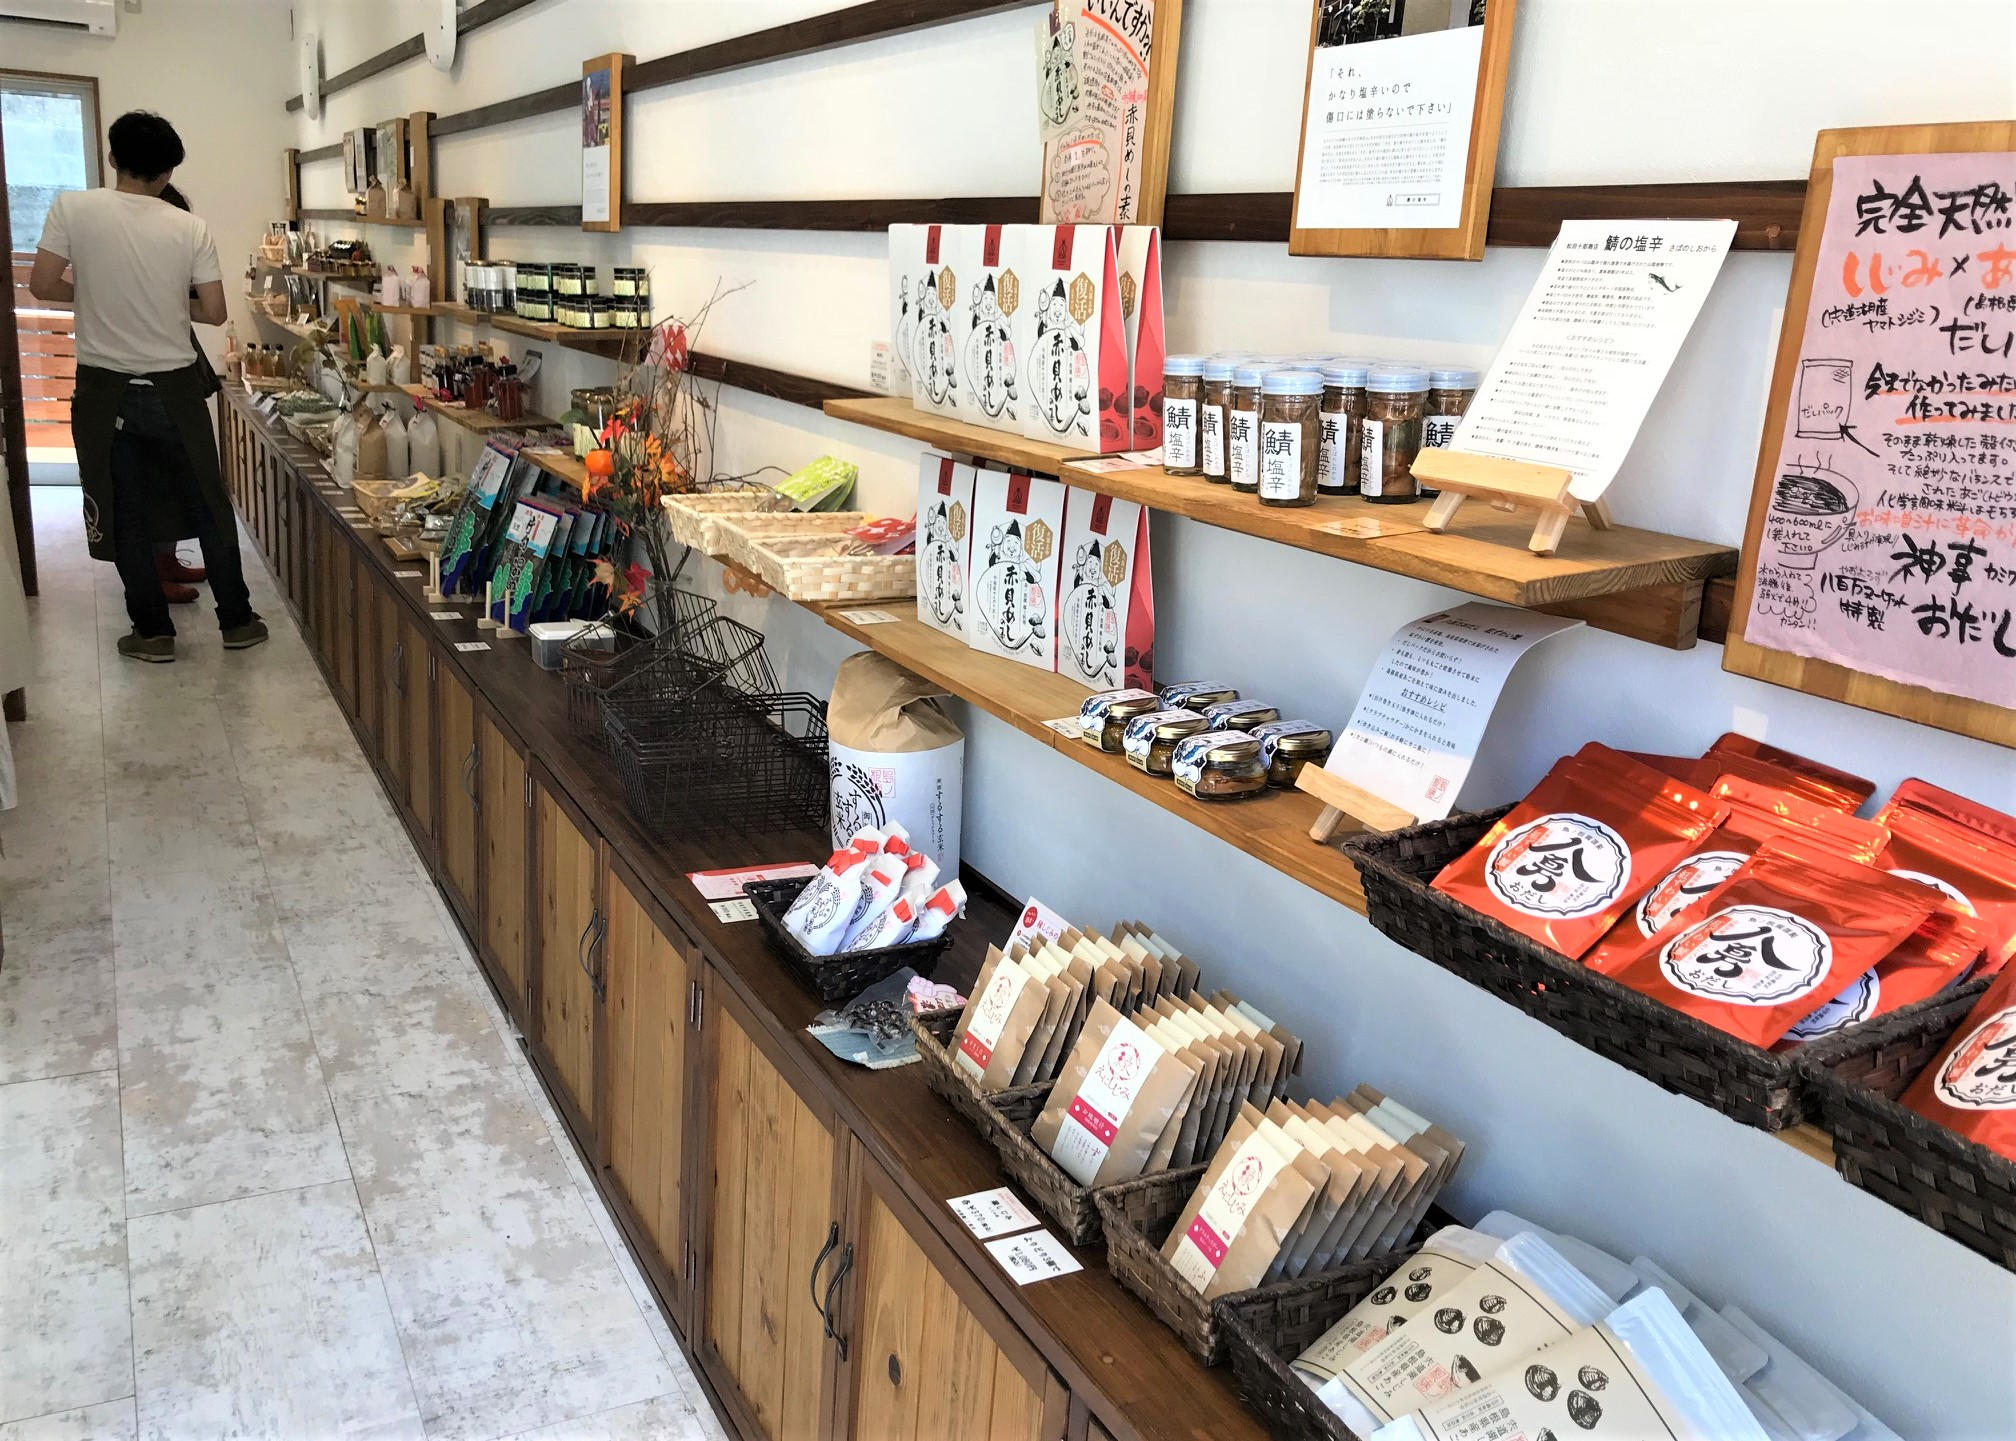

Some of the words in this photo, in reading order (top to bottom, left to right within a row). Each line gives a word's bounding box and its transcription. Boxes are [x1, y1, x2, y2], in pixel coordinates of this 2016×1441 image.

[1329, 66, 1362, 79] 「それ、
[1327, 82, 1412, 102] かなり塩辛いので
[1325, 102, 1454, 124] 傷口には塗らないで下さい」
[1118, 104, 1140, 221] 赤貝めしの素
[1854, 174, 2016, 240] 完全天然
[1603, 234, 1664, 253] 鯖の塩辛
[1668, 244, 1717, 254] さばのしおから
[1074, 278, 1088, 321] 復活
[983, 324, 997, 410] 赤貝めし
[1051, 332, 1064, 424] 赤貝めし
[1031, 522, 1047, 561] 復活
[1107, 544, 1122, 587] 復活
[1003, 565, 1018, 642] 赤貝めし
[1839, 598, 1885, 632] 特製
[1084, 587, 1098, 669] 赤貝めし
[1400, 687, 1448, 713] おすすめレシピ
[1509, 880, 1548, 905] おだし
[1688, 968, 1733, 990] おだし
